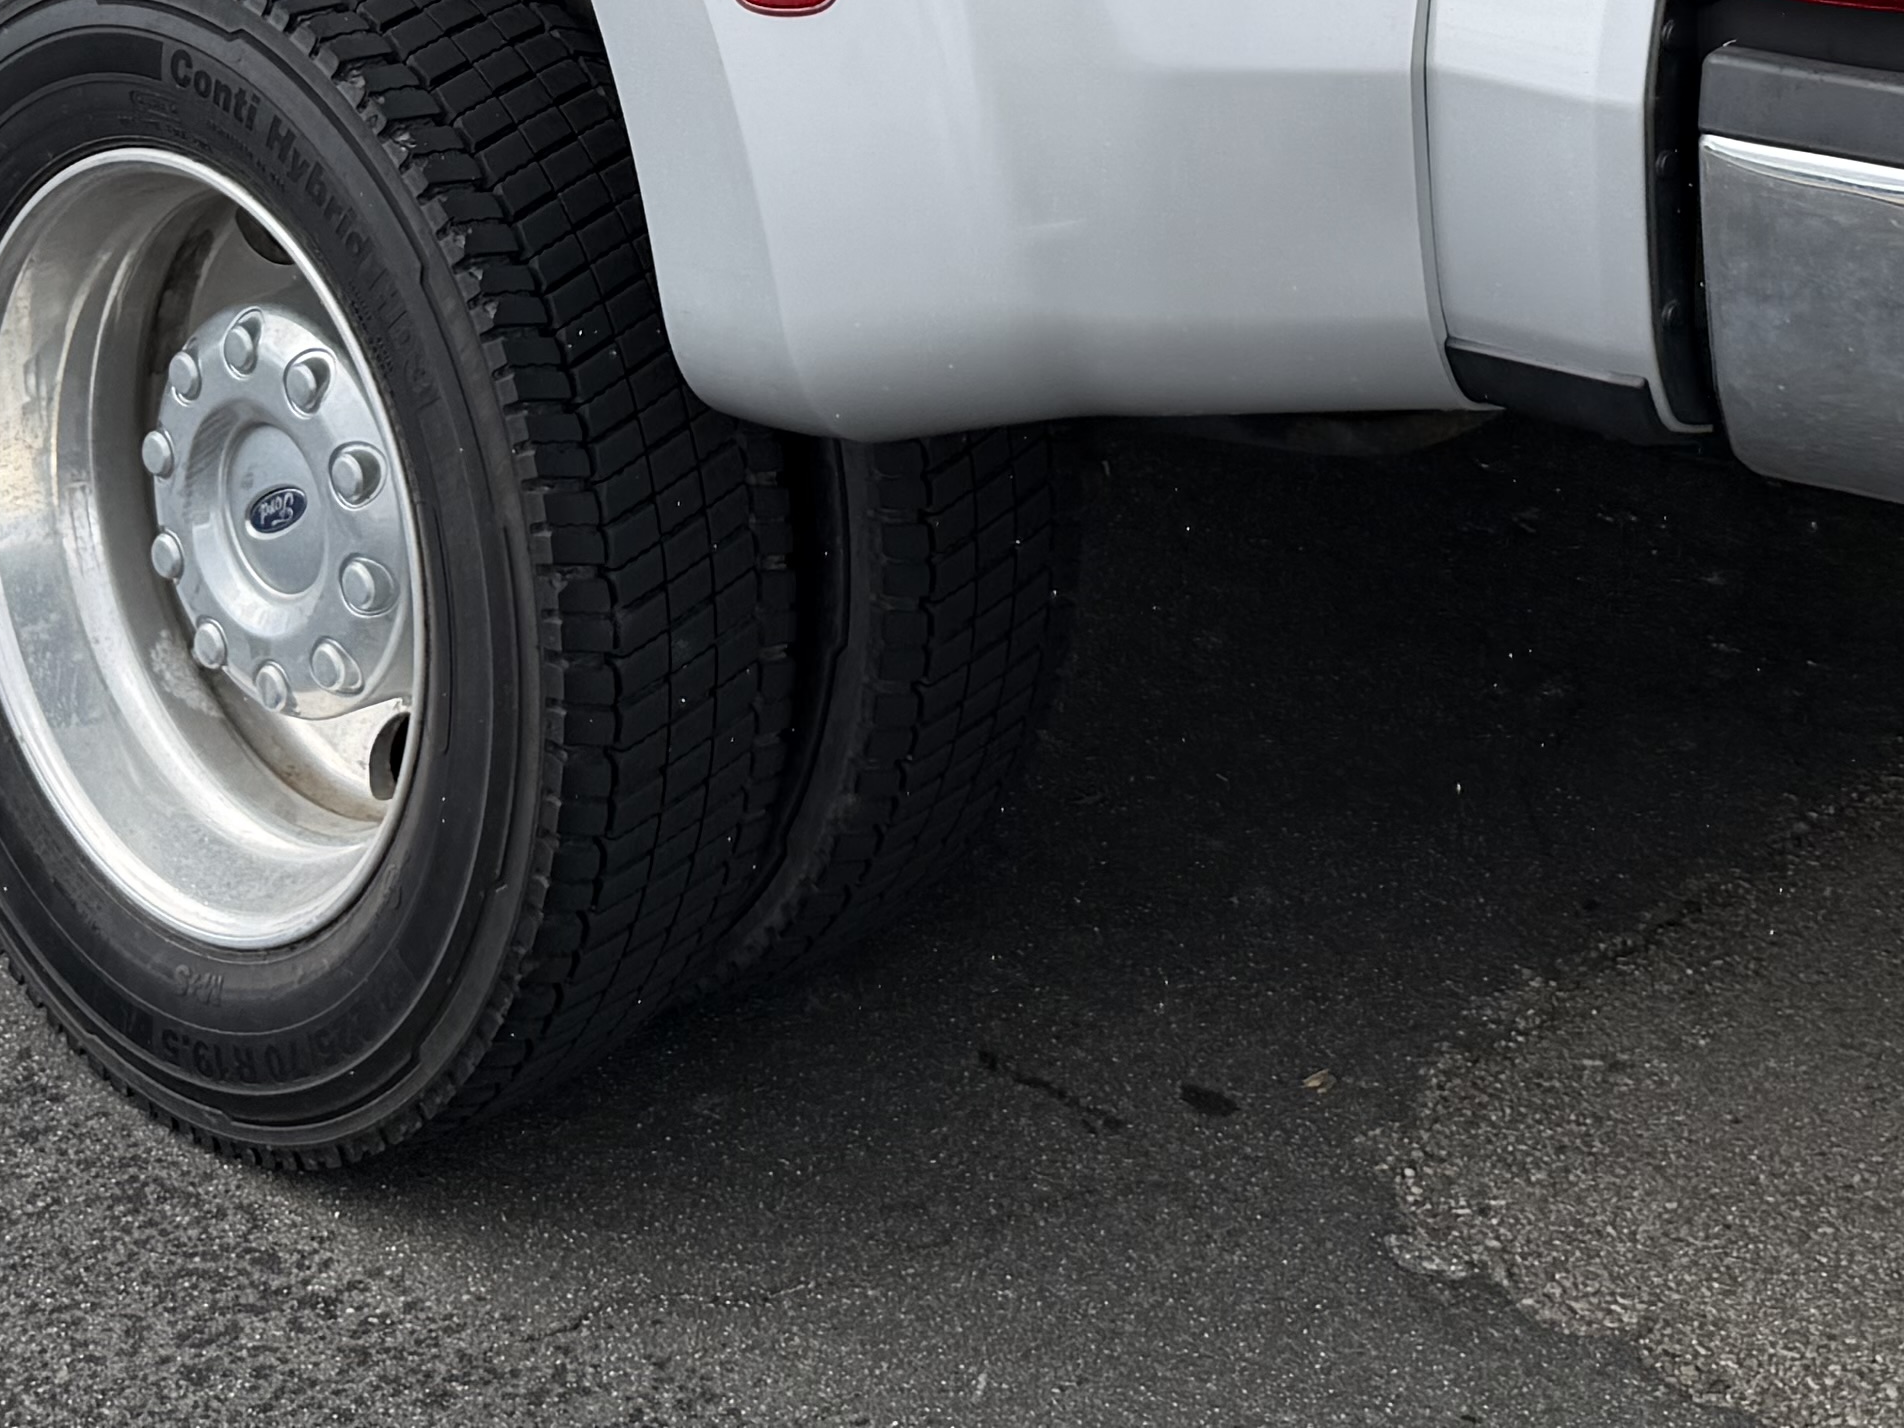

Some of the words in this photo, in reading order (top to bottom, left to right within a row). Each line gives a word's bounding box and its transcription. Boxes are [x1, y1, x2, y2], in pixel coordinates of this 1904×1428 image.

[169, 47, 261, 132] Conti
[264, 113, 374, 263] Hybrid
[258, 492, 294, 527] Ford
